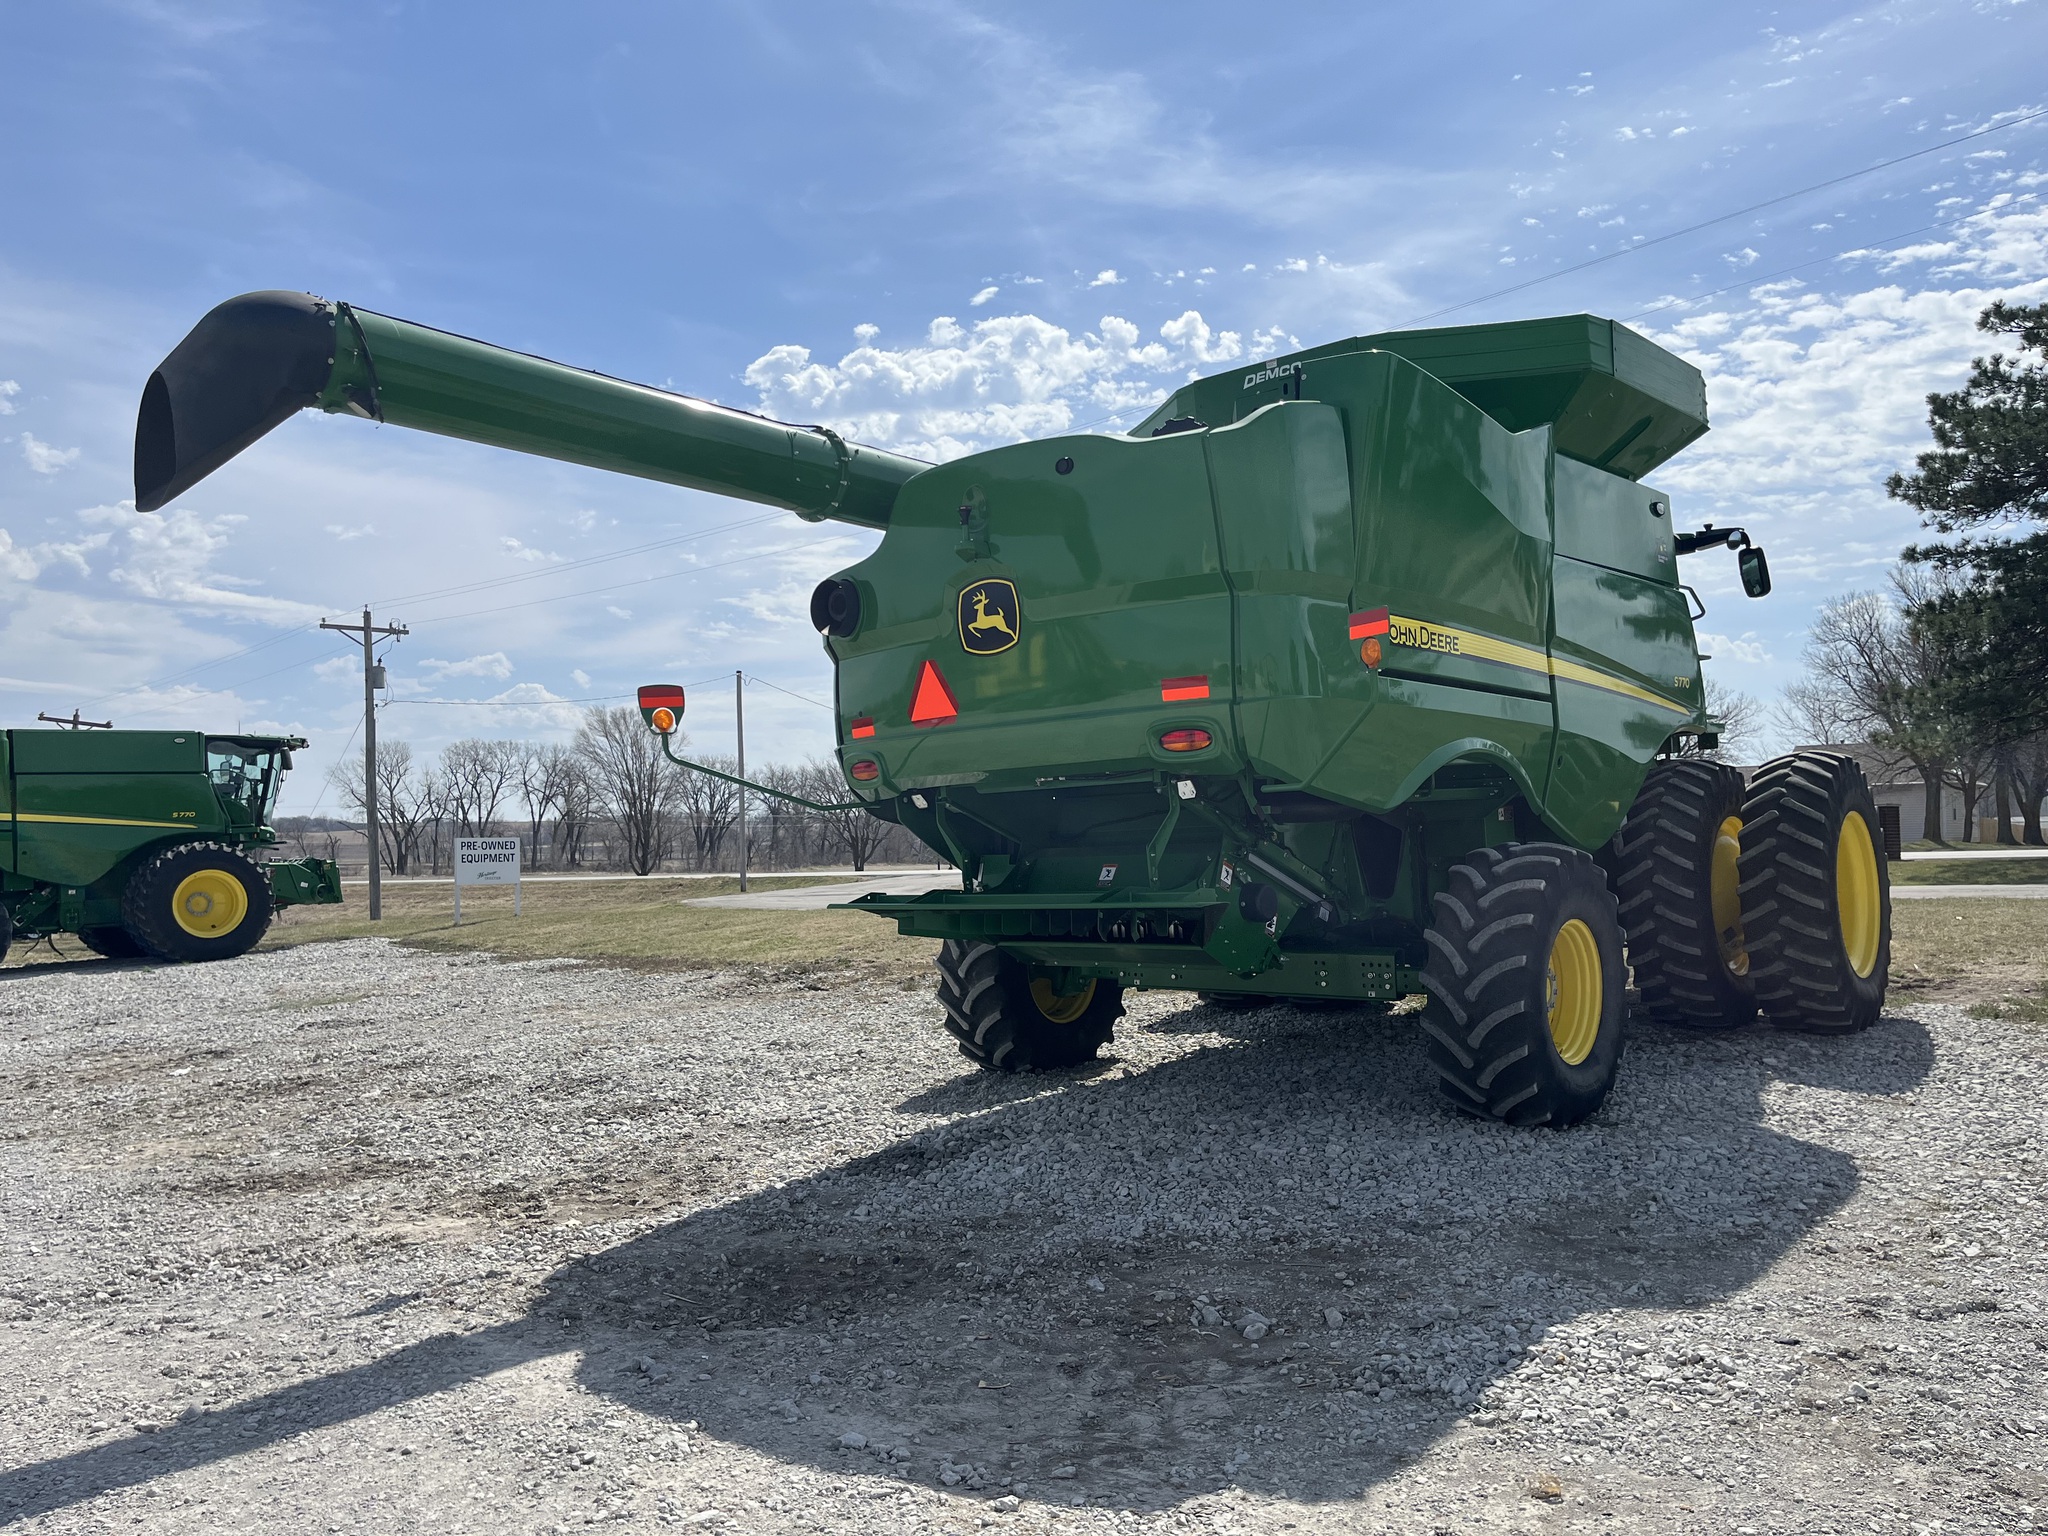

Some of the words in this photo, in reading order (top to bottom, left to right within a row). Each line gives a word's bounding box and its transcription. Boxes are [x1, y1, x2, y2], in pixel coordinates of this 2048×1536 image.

[1389, 624, 1417, 646] OHN
[1420, 626, 1460, 652] DEERE
[1674, 675, 1690, 689] S770
[460, 841, 516, 851] PRE-OWNED
[461, 853, 515, 864] EQUIPMENT
